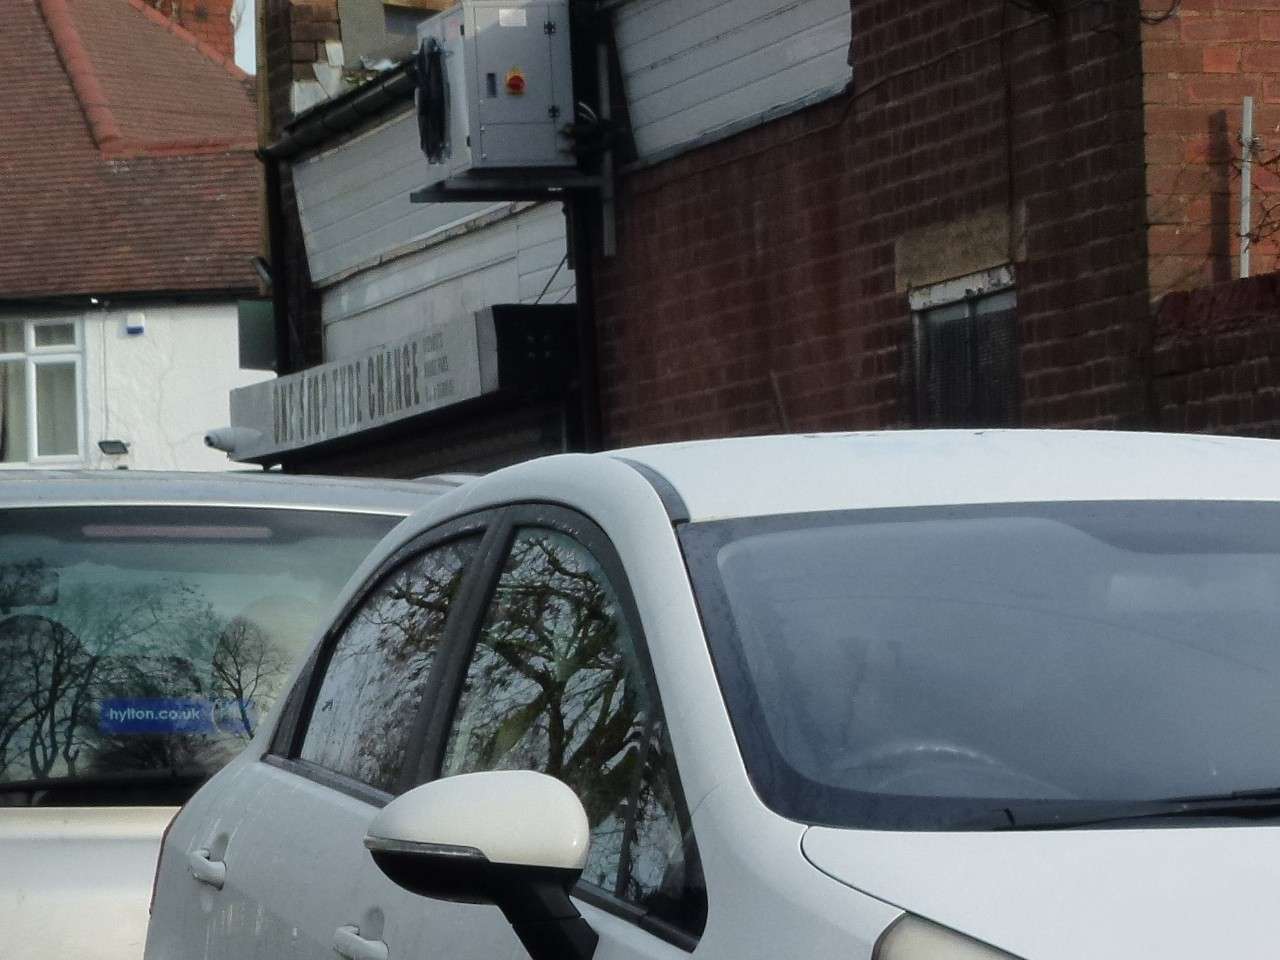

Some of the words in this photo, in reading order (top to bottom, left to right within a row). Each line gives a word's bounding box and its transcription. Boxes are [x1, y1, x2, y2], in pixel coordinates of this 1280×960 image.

[273, 383, 294, 444] ONE
[300, 372, 328, 441] STOP
[367, 341, 420, 420] CHANGE
[109, 707, 200, 723] hylton.co.uk
